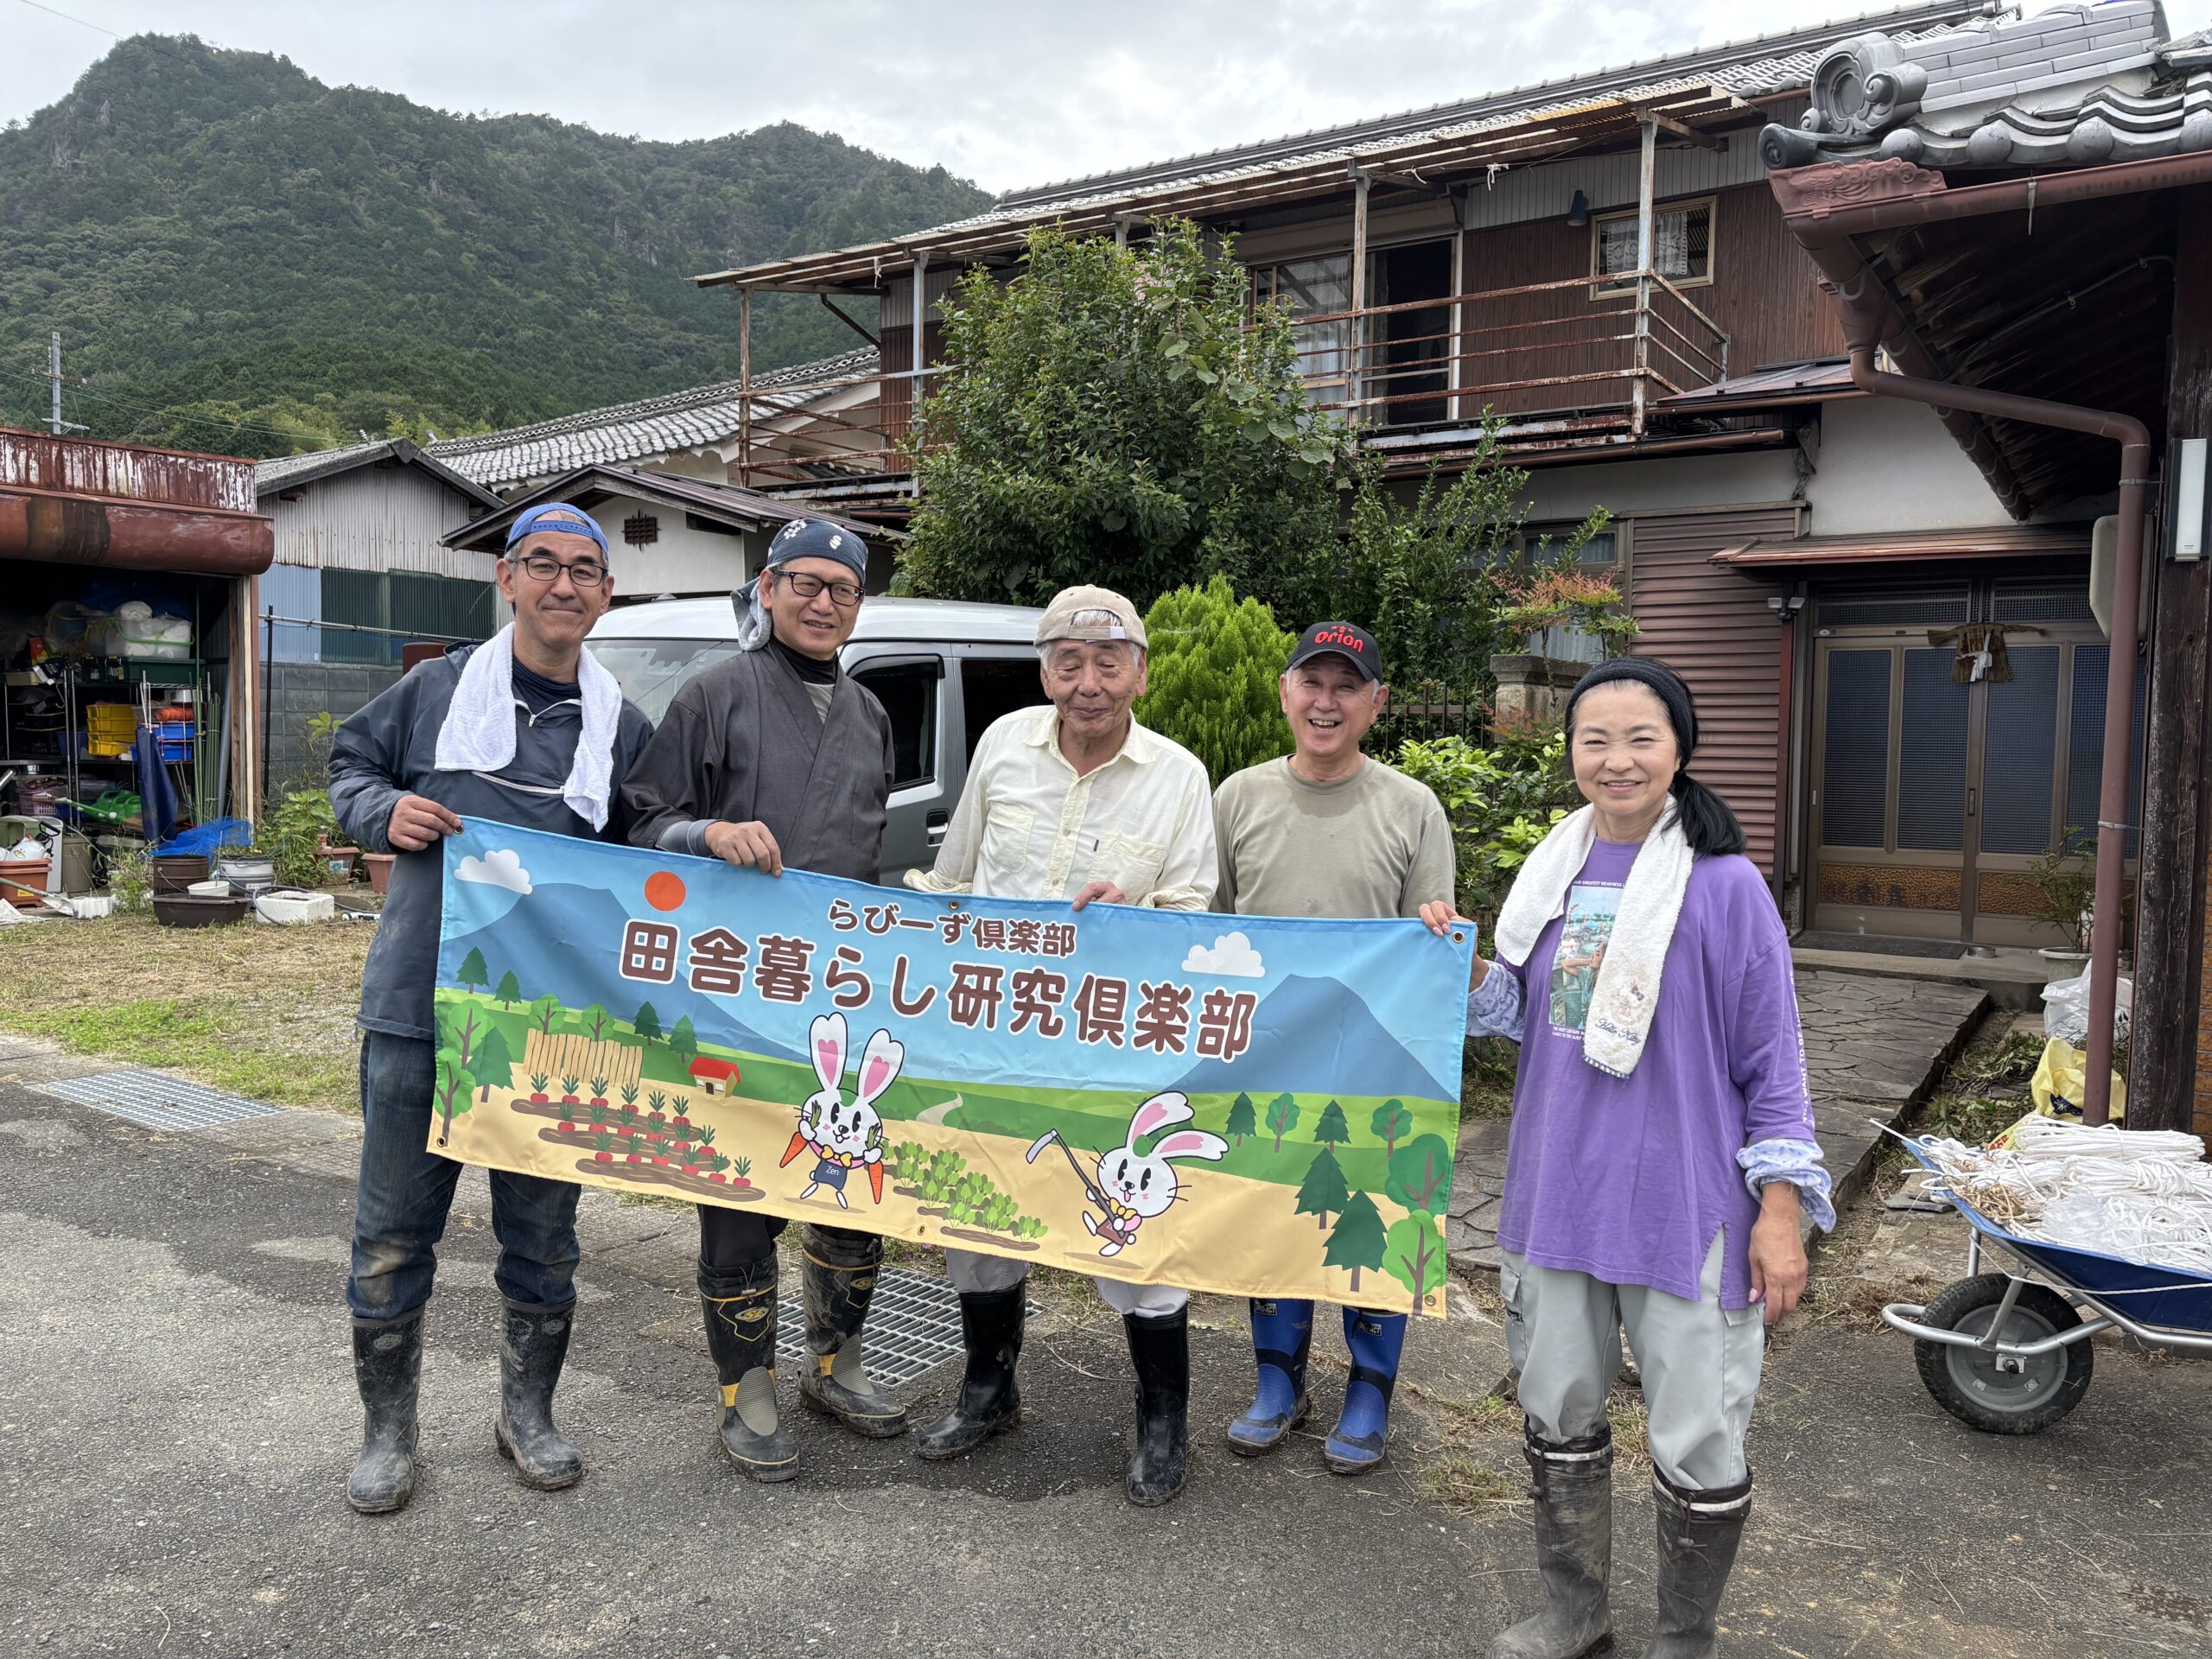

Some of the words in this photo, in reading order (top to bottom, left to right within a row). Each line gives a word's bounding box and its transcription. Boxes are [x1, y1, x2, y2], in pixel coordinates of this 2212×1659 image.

[829, 899, 1077, 957] らびーず倶楽部
[620, 919, 1257, 1062] 田舎暮らし研究倶楽部
[1595, 1018, 1618, 1034] Hello
[1618, 1027, 1642, 1046] Kitty
[1799, 1049, 1805, 1064] TO
[1800, 1066, 1808, 1097] WANT
[826, 1165, 839, 1176] Zen
